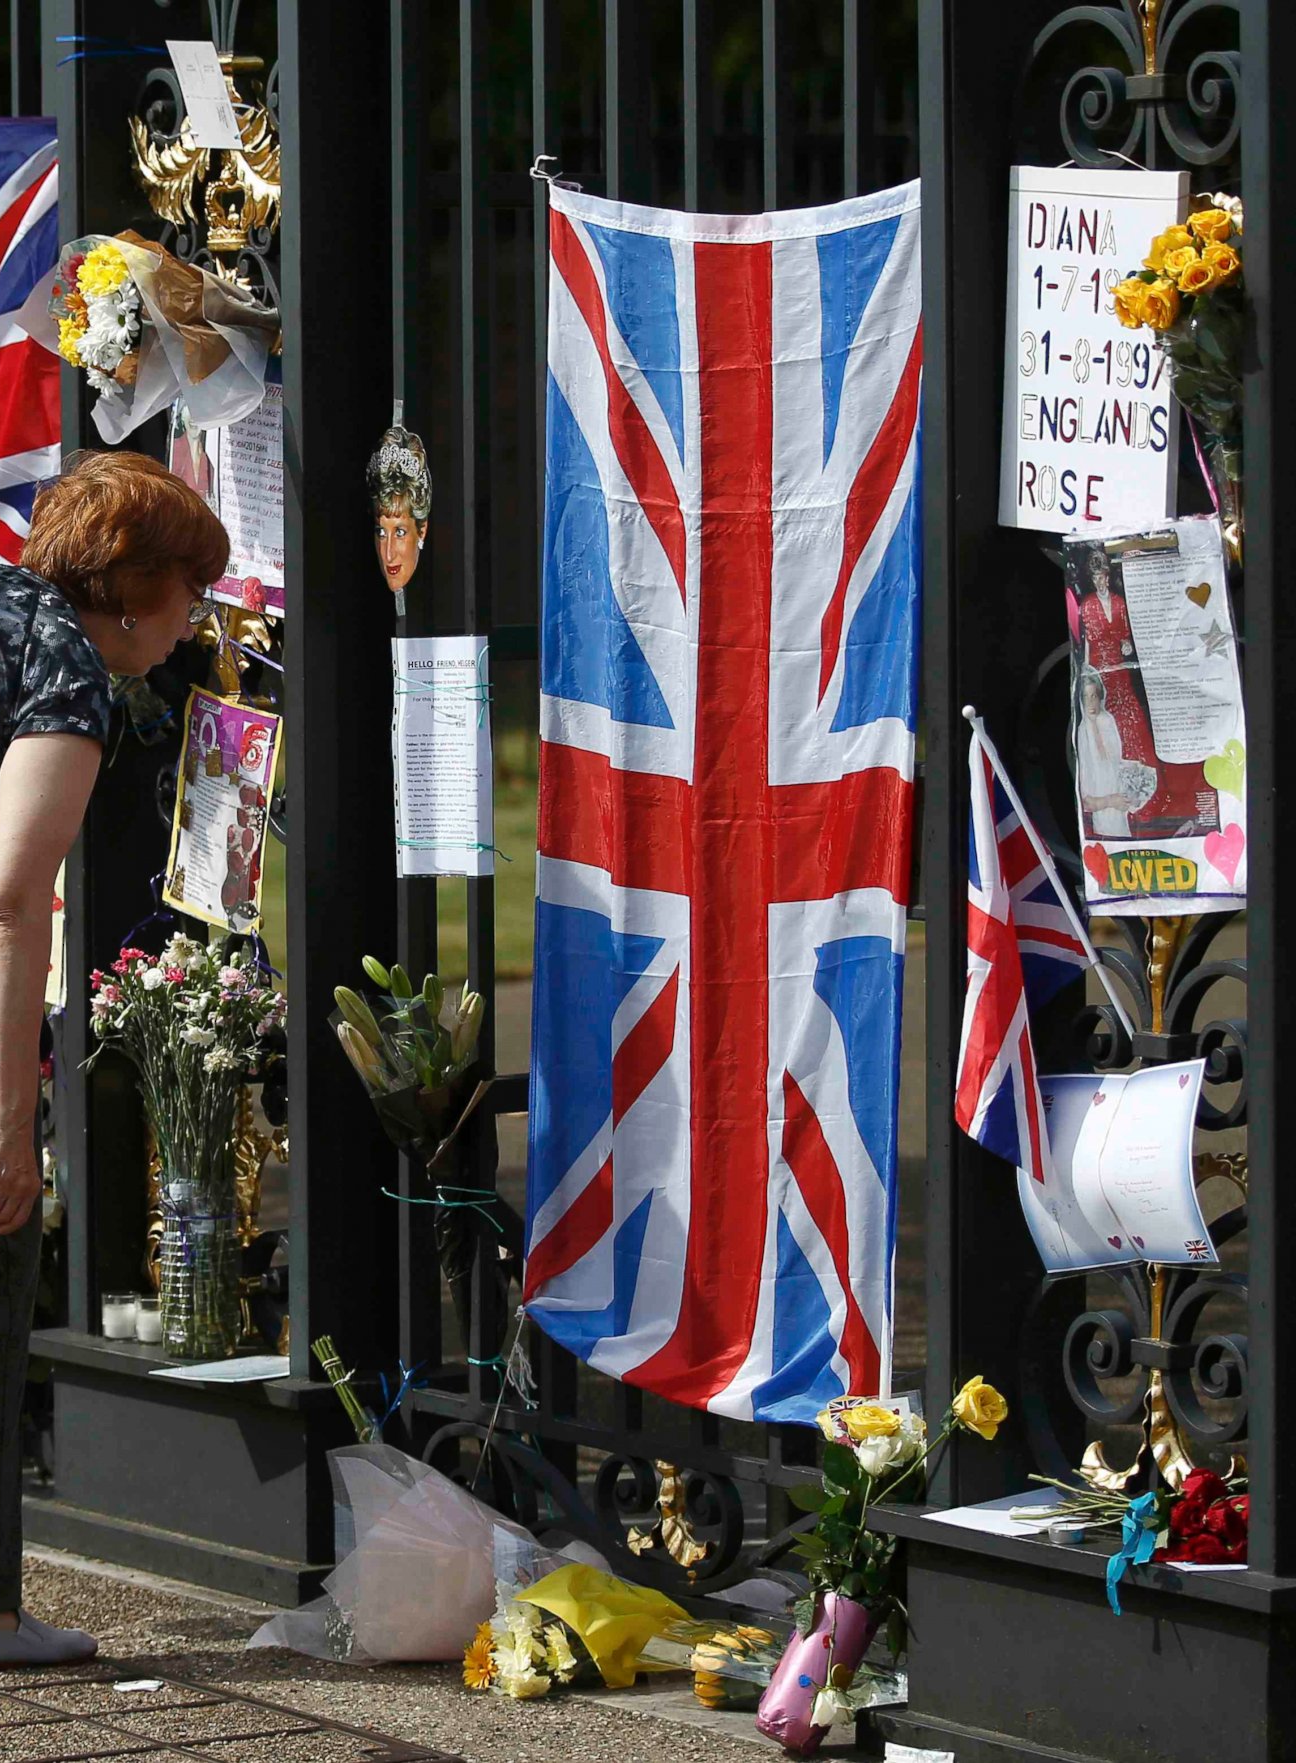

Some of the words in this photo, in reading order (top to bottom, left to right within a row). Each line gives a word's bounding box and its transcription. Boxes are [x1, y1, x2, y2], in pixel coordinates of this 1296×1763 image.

[1027, 202, 1118, 257] DIANA
[1033, 263, 1138, 316] 1-7-19
[1019, 329, 1167, 391] 31-8-1997
[1019, 393, 1169, 453] ENGLANDS
[1018, 460, 1105, 522] ROSE
[407, 660, 434, 669] HELLO
[1107, 857, 1197, 892] LOVED
